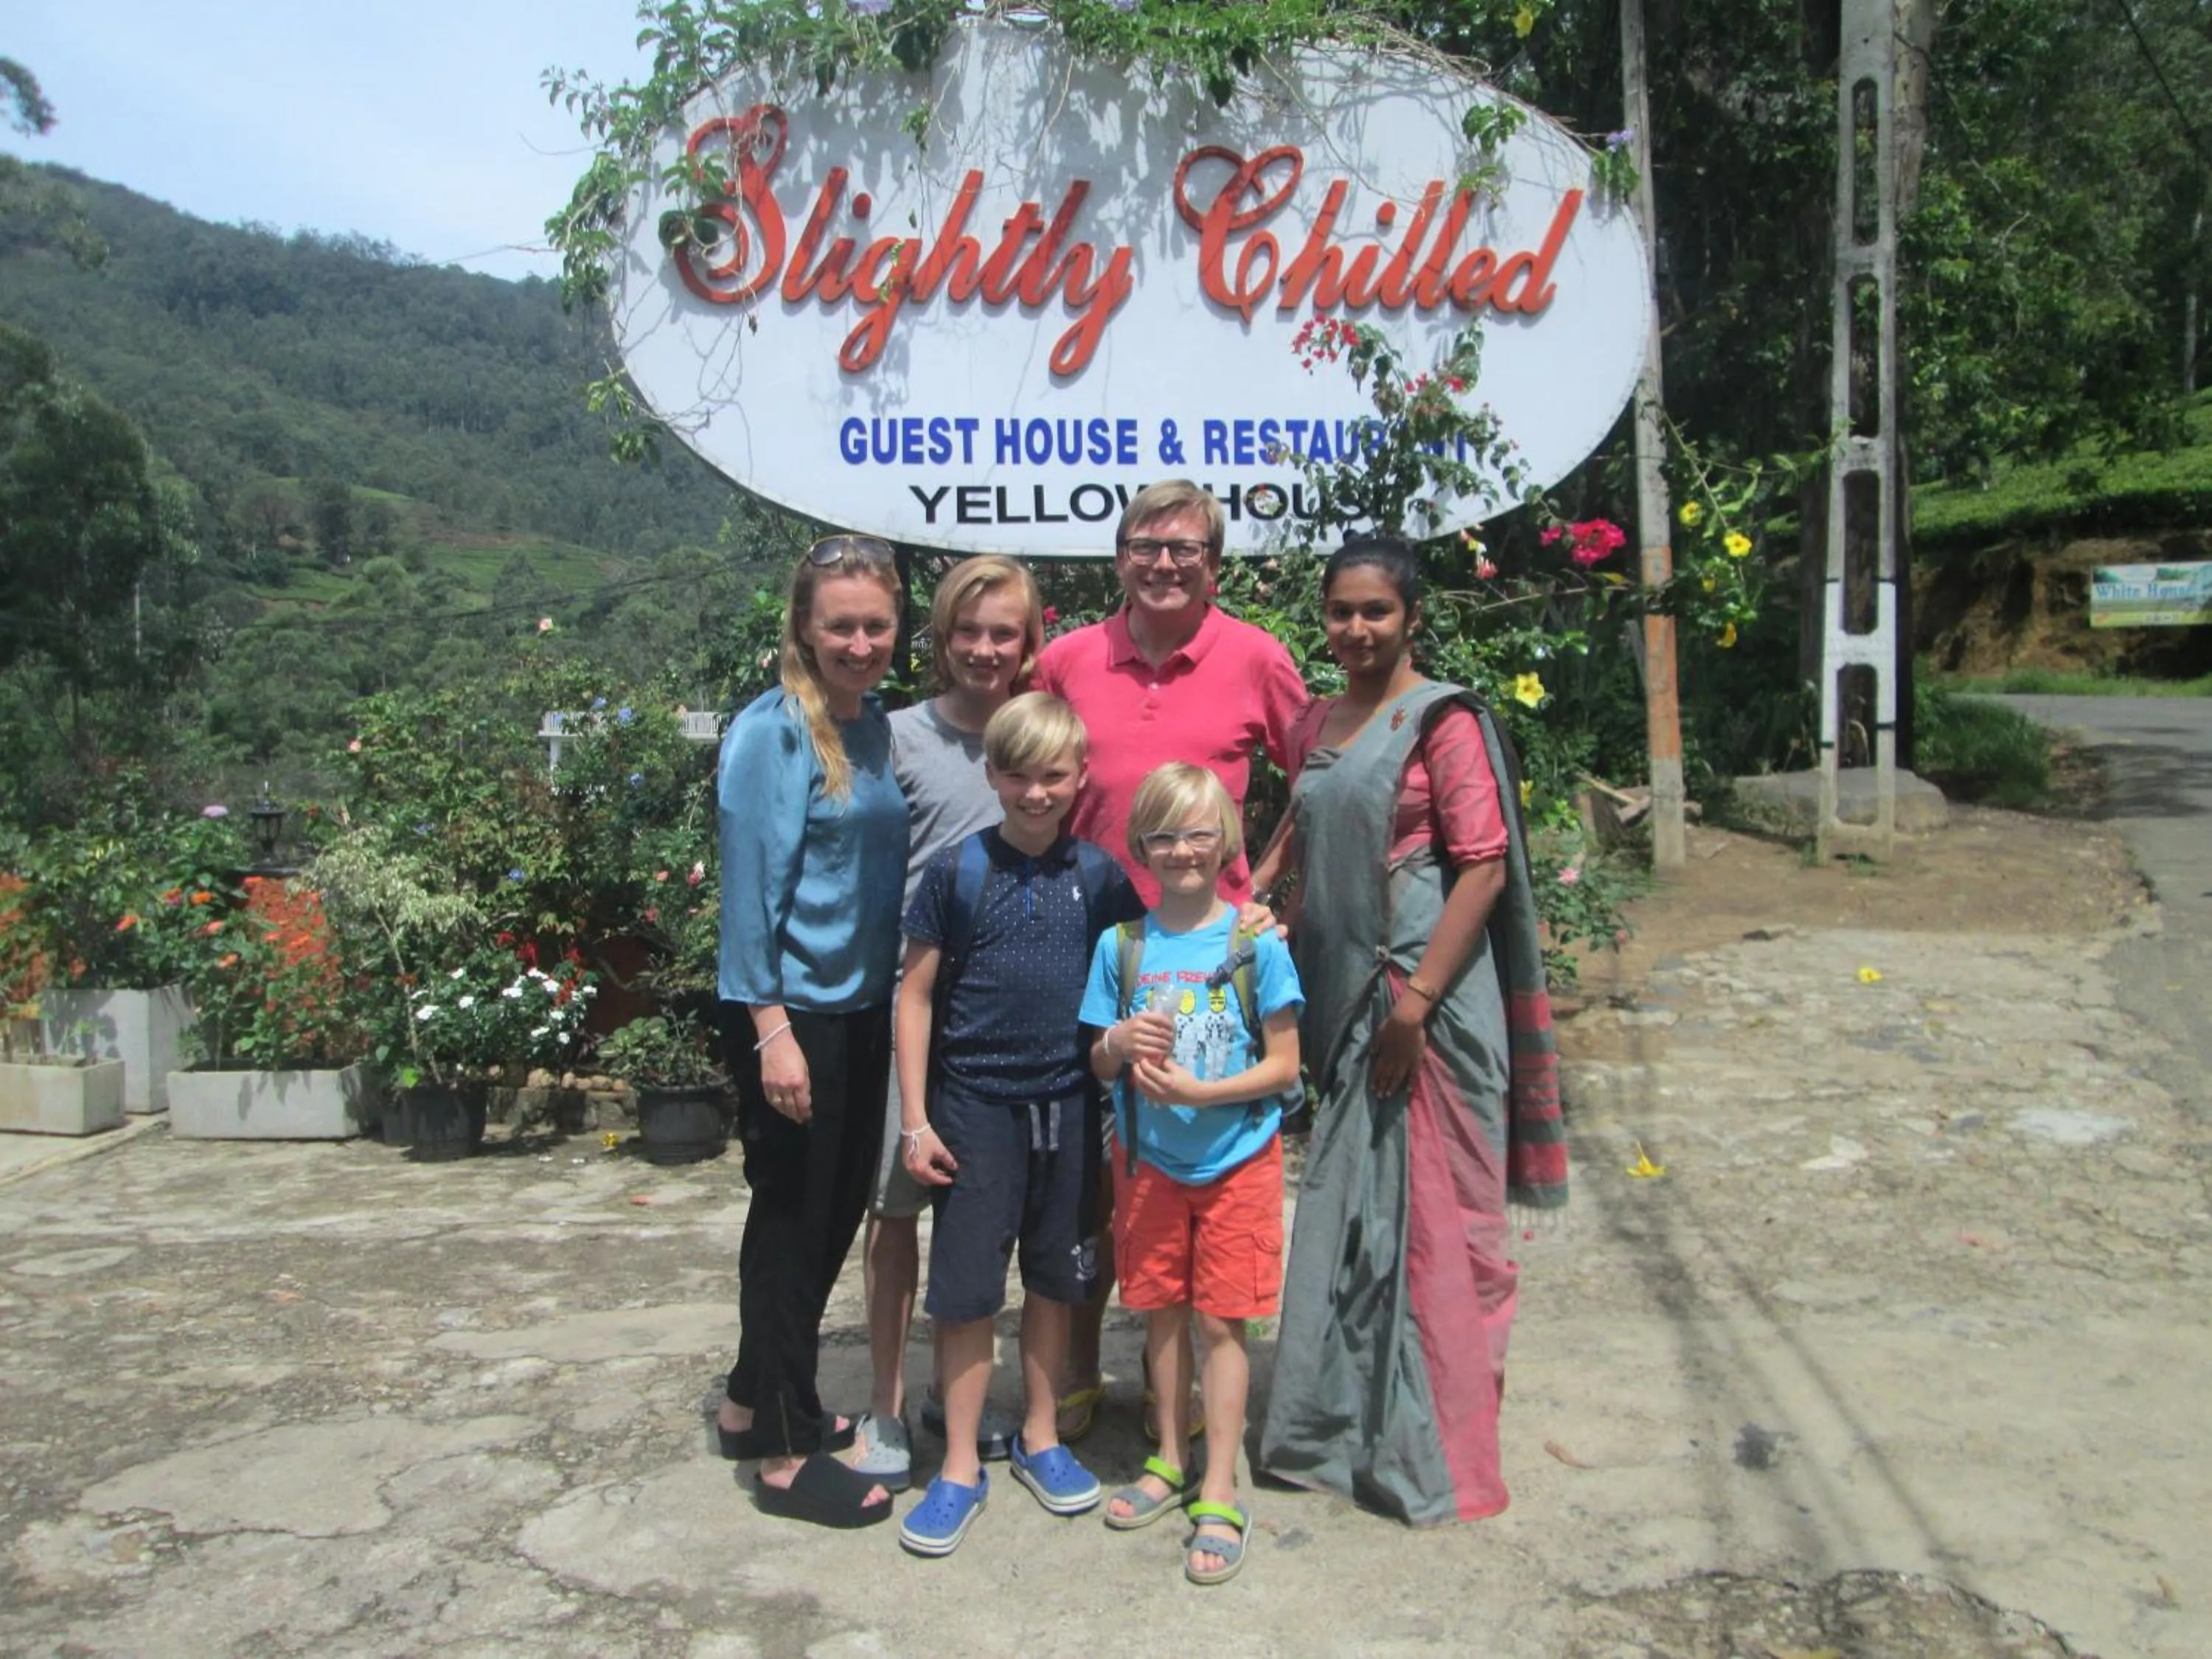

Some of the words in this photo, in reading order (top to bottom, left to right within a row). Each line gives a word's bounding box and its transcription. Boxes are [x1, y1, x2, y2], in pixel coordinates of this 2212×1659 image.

[672, 103, 1133, 375] Slightly
[1174, 145, 1584, 322] Chilled
[840, 417, 979, 465] GUEST
[995, 417, 1138, 465] HOUSE
[1158, 418, 1186, 465] &
